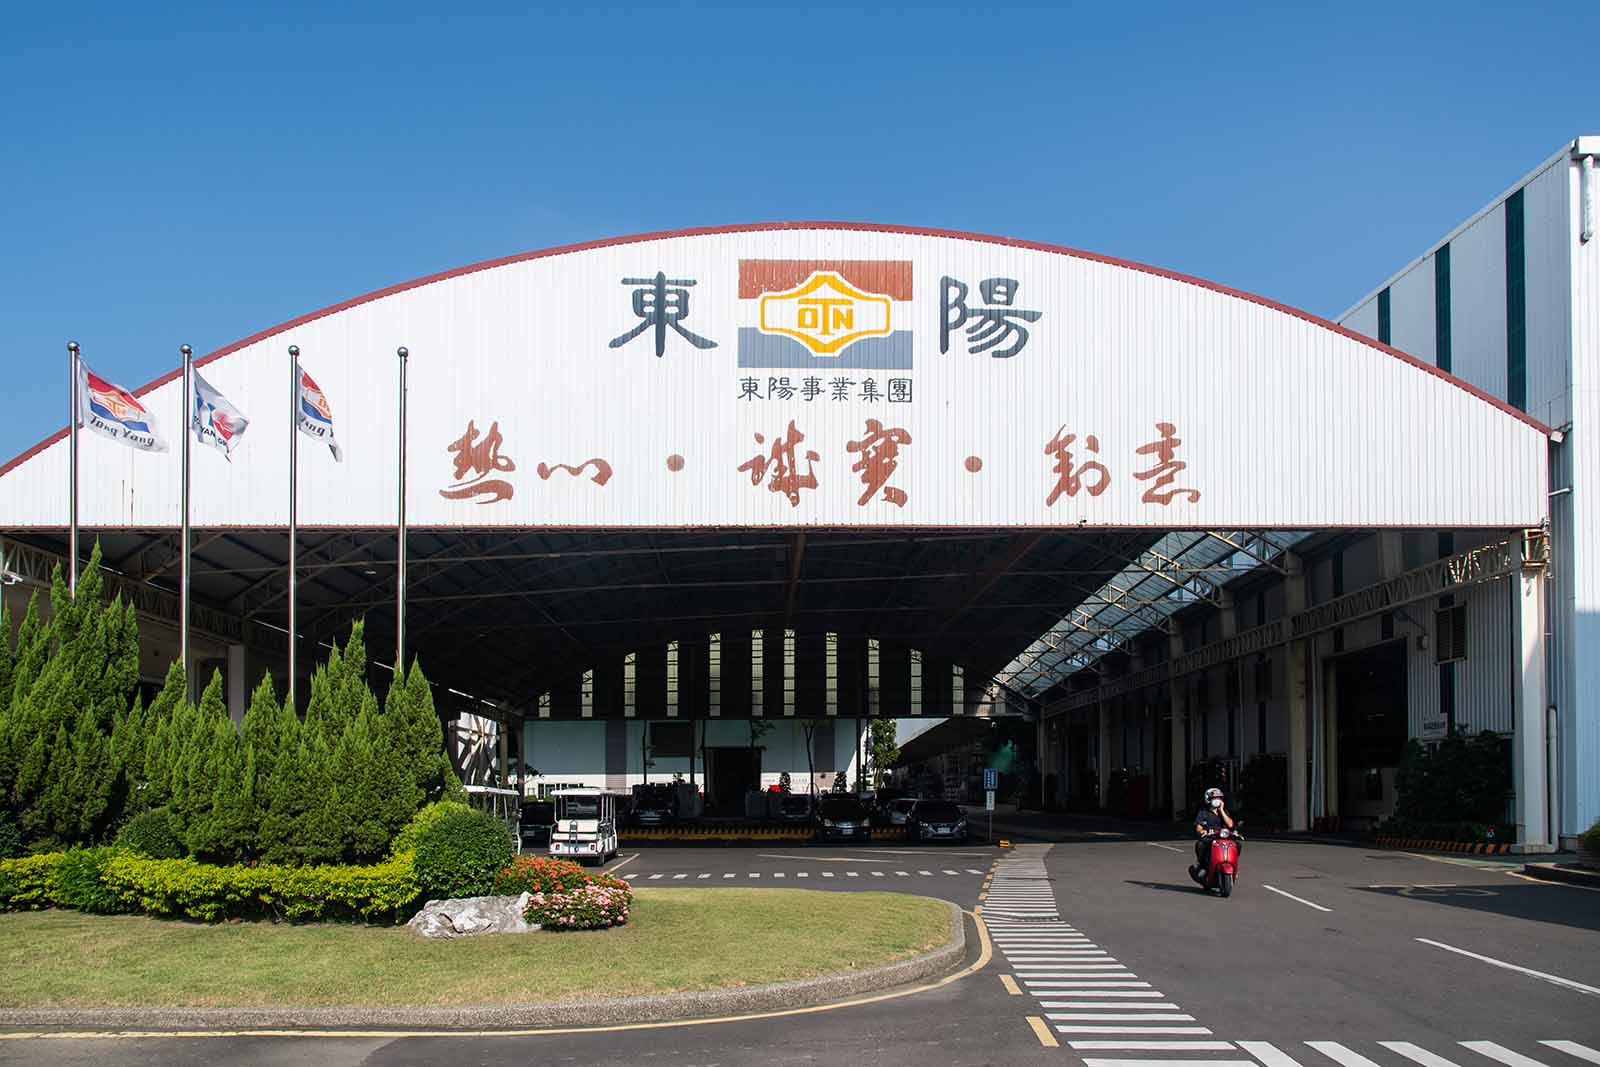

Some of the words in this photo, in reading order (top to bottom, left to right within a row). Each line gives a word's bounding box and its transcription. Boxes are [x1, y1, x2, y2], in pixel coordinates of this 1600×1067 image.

[737, 376, 913, 404] 東陽事業集團
[121, 427, 155, 447] Yang
